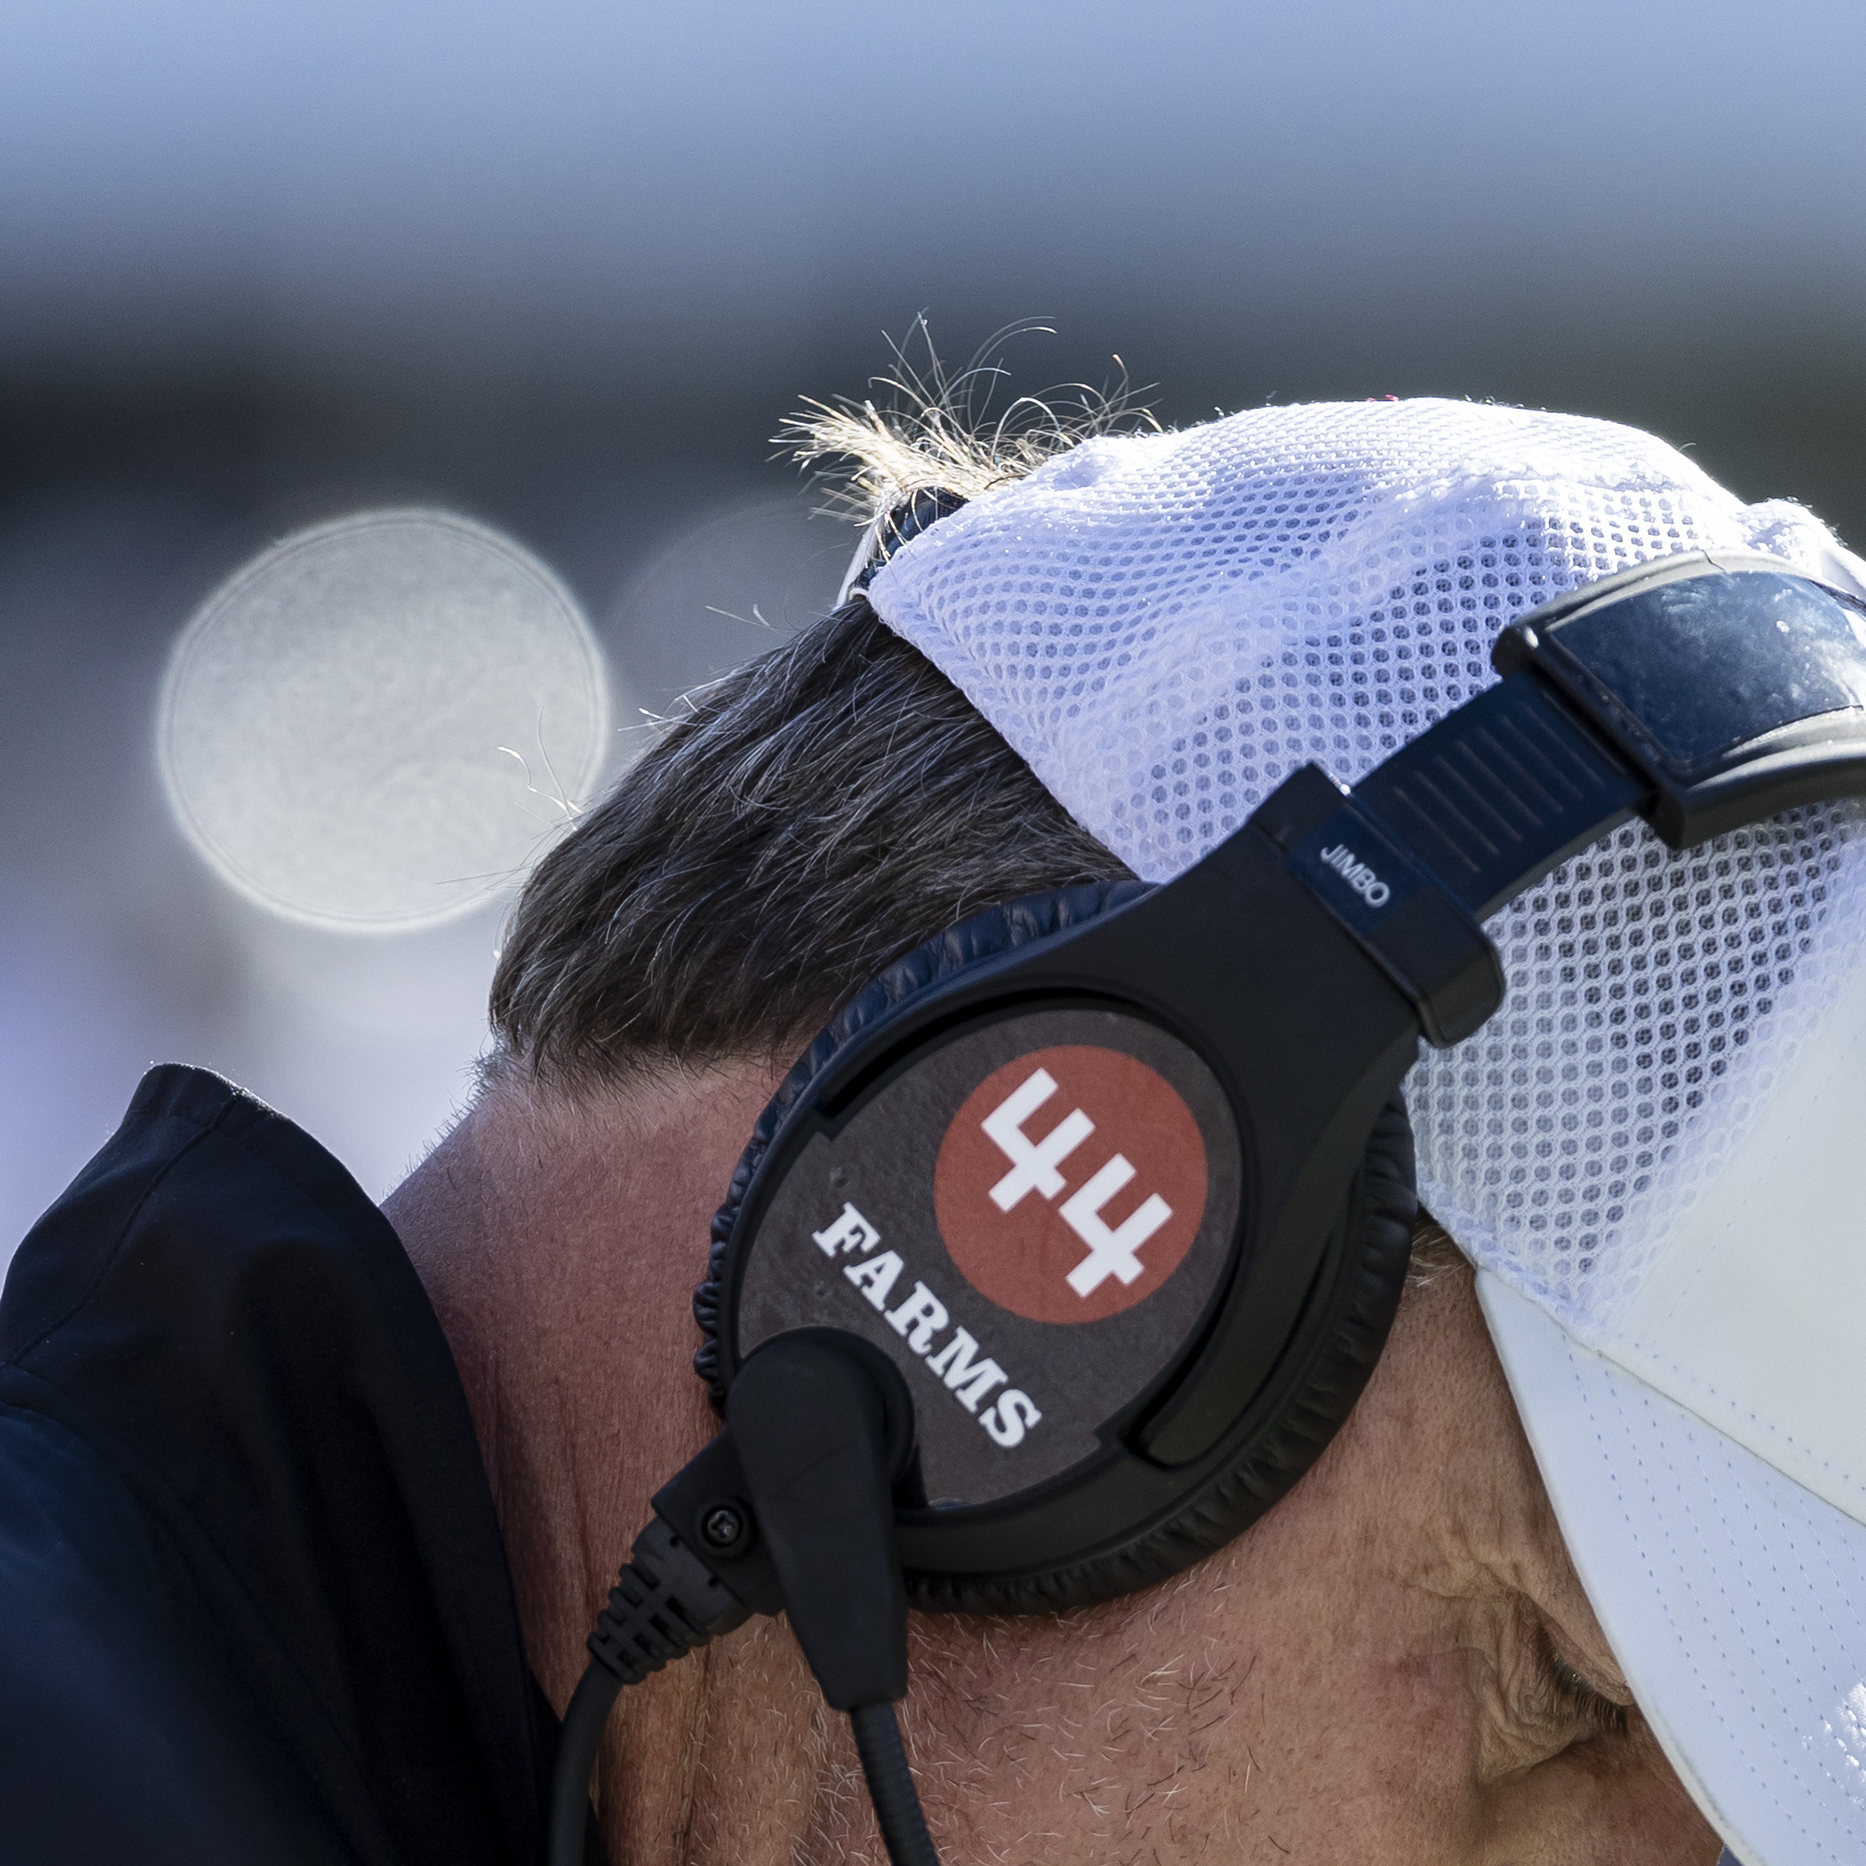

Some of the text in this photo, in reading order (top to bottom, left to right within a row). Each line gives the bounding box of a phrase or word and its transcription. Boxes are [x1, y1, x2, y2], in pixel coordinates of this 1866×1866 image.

[1320, 843, 1390, 908] JIMBO
[981, 1067, 1173, 1297] 44
[812, 1202, 1042, 1448] FARMS
